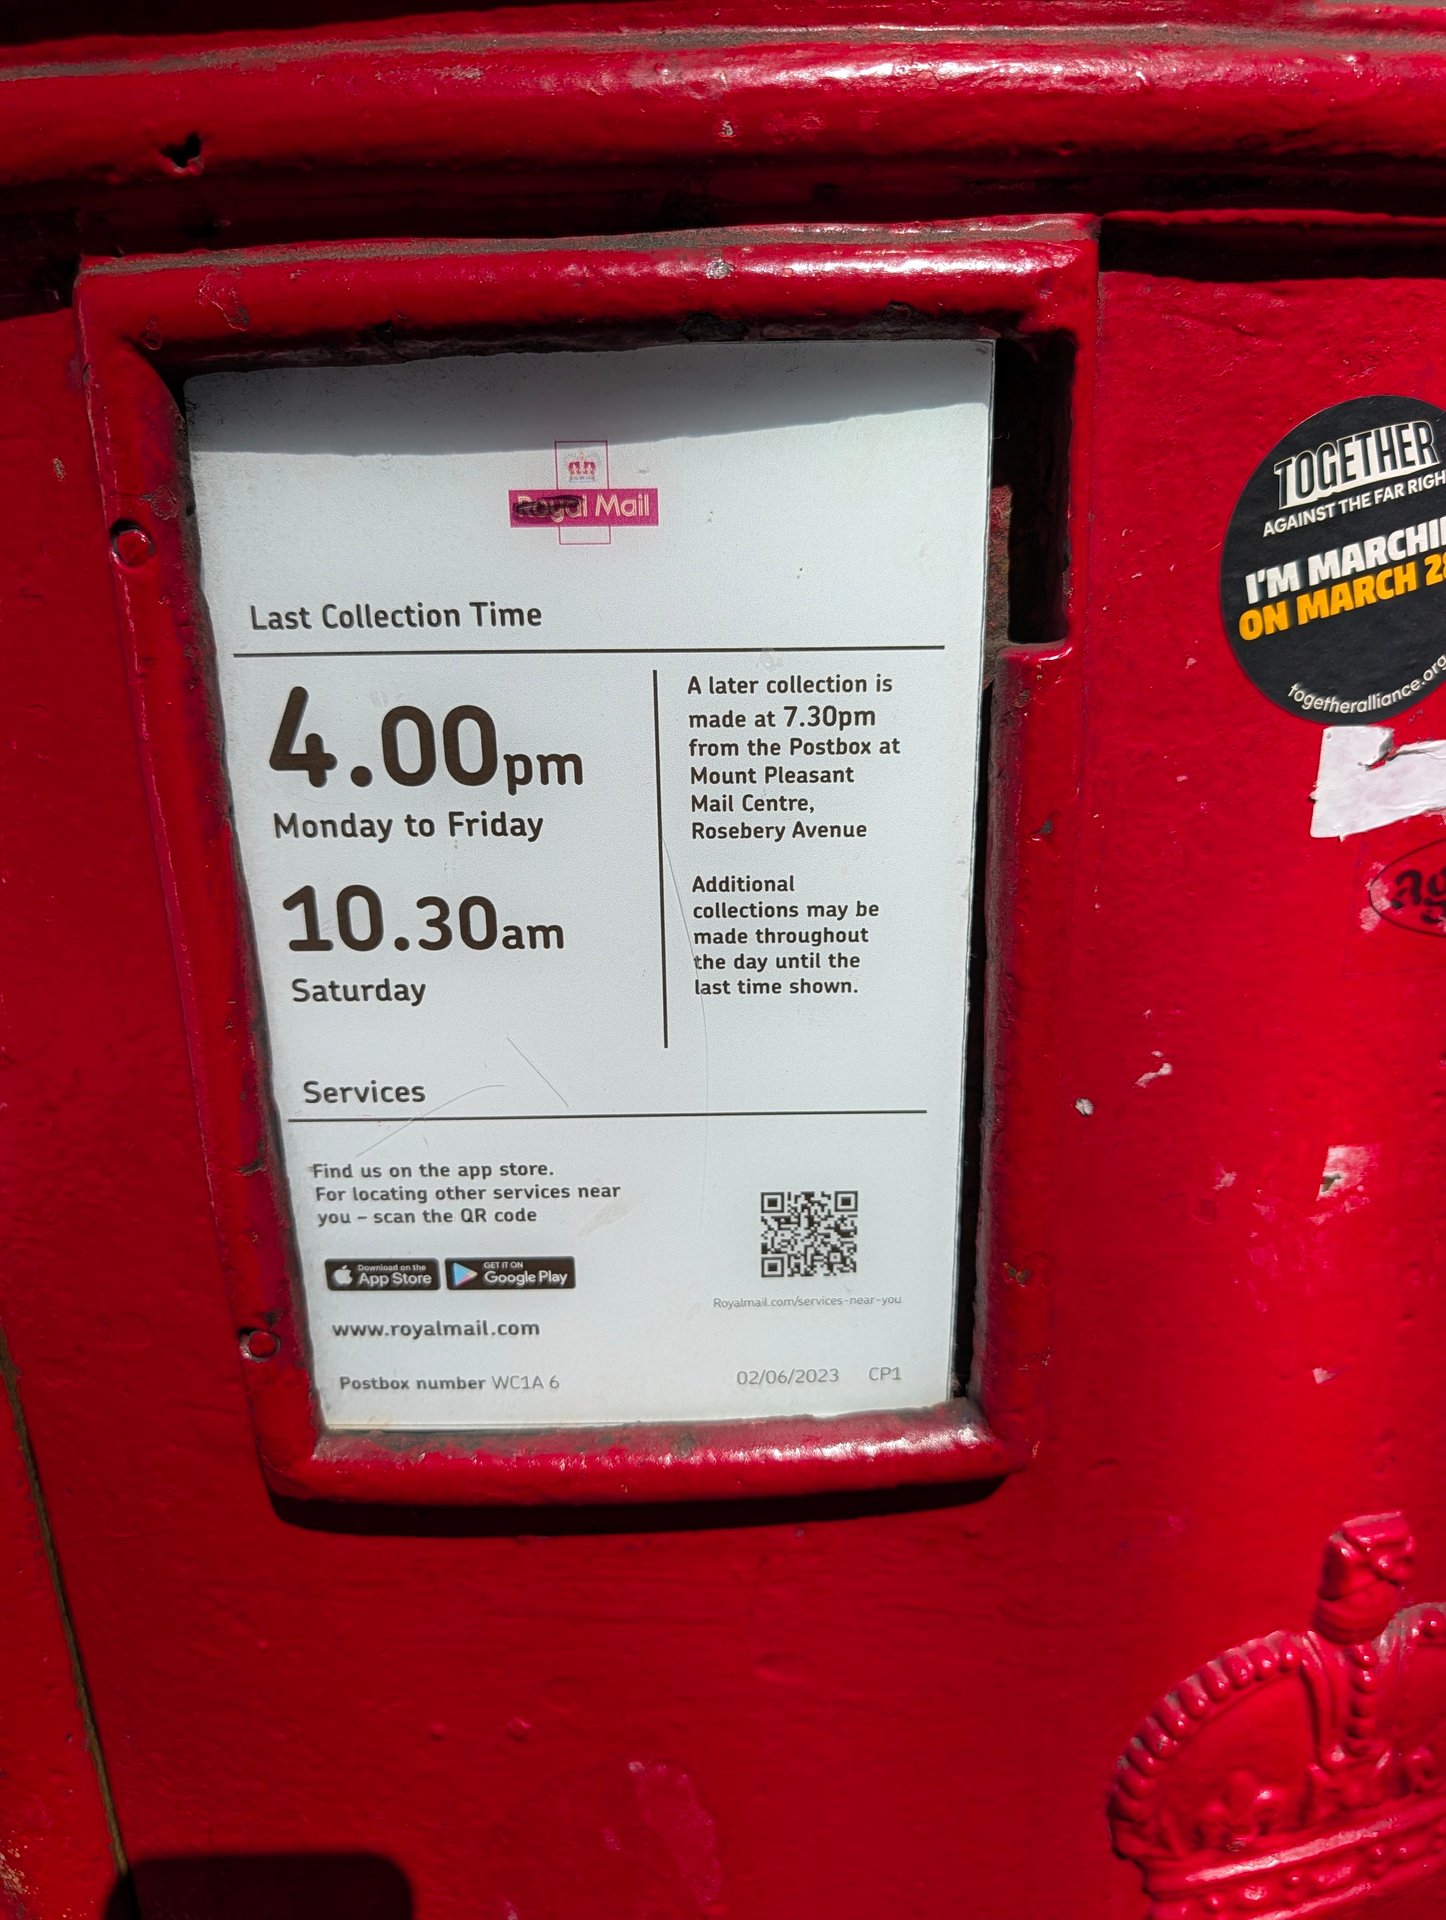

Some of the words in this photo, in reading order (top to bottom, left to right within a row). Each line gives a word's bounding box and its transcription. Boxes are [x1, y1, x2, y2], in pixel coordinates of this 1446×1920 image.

[1274, 420, 1440, 510] TOGETHER
[595, 494, 650, 518] Mail
[1262, 503, 1337, 538] AGAINST
[1338, 492, 1372, 516] THE
[1374, 483, 1406, 506] FAR
[1407, 469, 1446, 495] RIGH
[1245, 563, 1300, 605] I'M
[1239, 600, 1288, 641] ON
[1297, 560, 1417, 626] MARCH
[1424, 552, 1446, 586] 2
[250, 605, 312, 630] Last
[322, 602, 460, 629] Collection
[469, 601, 542, 627] Time
[687, 676, 702, 695] A
[709, 676, 759, 694] later
[766, 674, 867, 694] collection
[876, 673, 892, 692] is
[688, 709, 747, 728] made
[754, 711, 777, 728] at
[783, 705, 875, 731] 7.30pm
[269, 686, 583, 796] 4.00pm
[689, 738, 739, 757] from
[747, 738, 781, 756] the
[790, 737, 871, 756] Postbox
[879, 738, 900, 754] at
[691, 766, 757, 784] Mount
[765, 766, 854, 784] Pleasant
[691, 794, 734, 812] Mail
[742, 794, 815, 814] Centre,
[274, 812, 393, 843] Monday
[404, 814, 435, 837] to
[448, 810, 544, 843] Friday
[692, 822, 786, 842] Rosebery
[792, 821, 867, 839] Avenue
[692, 875, 795, 893] Additional
[282, 884, 564, 952] 10.30am
[693, 901, 799, 918] collections
[806, 905, 848, 921] may
[855, 900, 879, 917] be
[693, 928, 748, 944] made
[755, 927, 869, 947] throughout
[693, 954, 726, 969] the
[734, 953, 768, 973] day
[776, 952, 821, 969] until
[828, 952, 860, 968] the
[292, 978, 426, 1007] Saturday
[695, 979, 731, 995] last
[737, 978, 782, 994] time
[790, 978, 858, 994] shown.
[303, 1080, 426, 1104] Services
[313, 1163, 354, 1178] Find
[361, 1167, 382, 1178] us
[389, 1167, 412, 1178] on
[419, 1162, 450, 1177] the
[458, 1165, 492, 1180] app
[500, 1162, 554, 1176] store.
[316, 1187, 346, 1201] For
[353, 1186, 427, 1204] locating
[435, 1185, 487, 1200] other
[493, 1184, 570, 1200] services
[578, 1187, 621, 1198] near
[318, 1213, 351, 1227] you
[373, 1213, 415, 1223] scan
[422, 1209, 453, 1223] the
[461, 1208, 487, 1223] QR
[495, 1207, 537, 1222] code
[358, 1273, 390, 1287] App
[392, 1272, 432, 1286] Store
[484, 1270, 536, 1286] Google
[538, 1269, 567, 1285] Play
[714, 1296, 902, 1309] Royalmail.com/services-near-you
[332, 1320, 539, 1340] www.royalmail.com
[340, 1376, 410, 1390] Postbox
[416, 1376, 486, 1390] number
[491, 1375, 544, 1390] WC1A
[549, 1375, 559, 1389] 6
[737, 1368, 840, 1385] 02/06/2023
[869, 1367, 901, 1381] CP1
